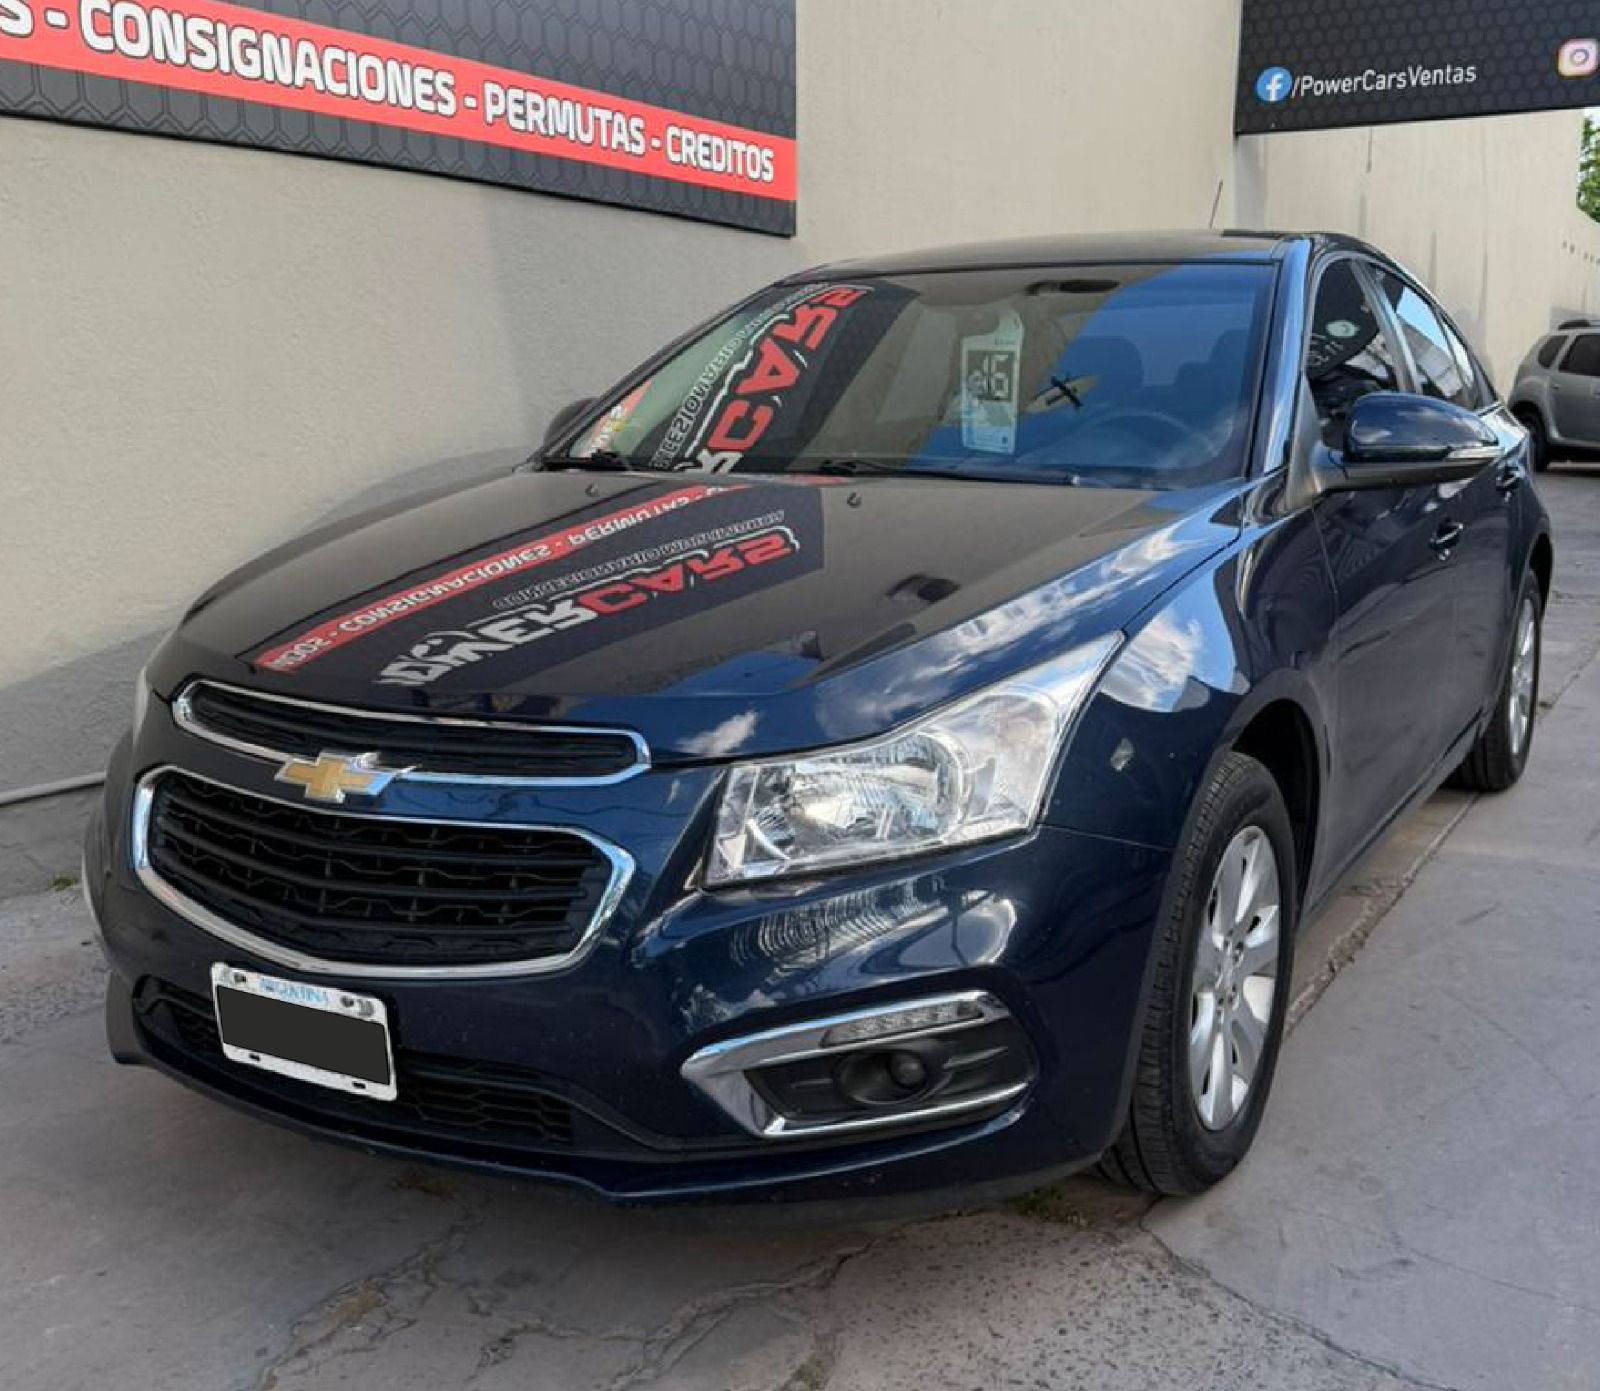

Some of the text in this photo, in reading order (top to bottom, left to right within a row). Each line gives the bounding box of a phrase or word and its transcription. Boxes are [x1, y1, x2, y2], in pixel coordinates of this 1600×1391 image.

[81, 0, 455, 116] CONSIGNACIONES
[483, 81, 645, 155] PERMUTAS
[665, 125, 774, 183] CREDITOS
[1291, 63, 1477, 98] /PowerCarsVentas
